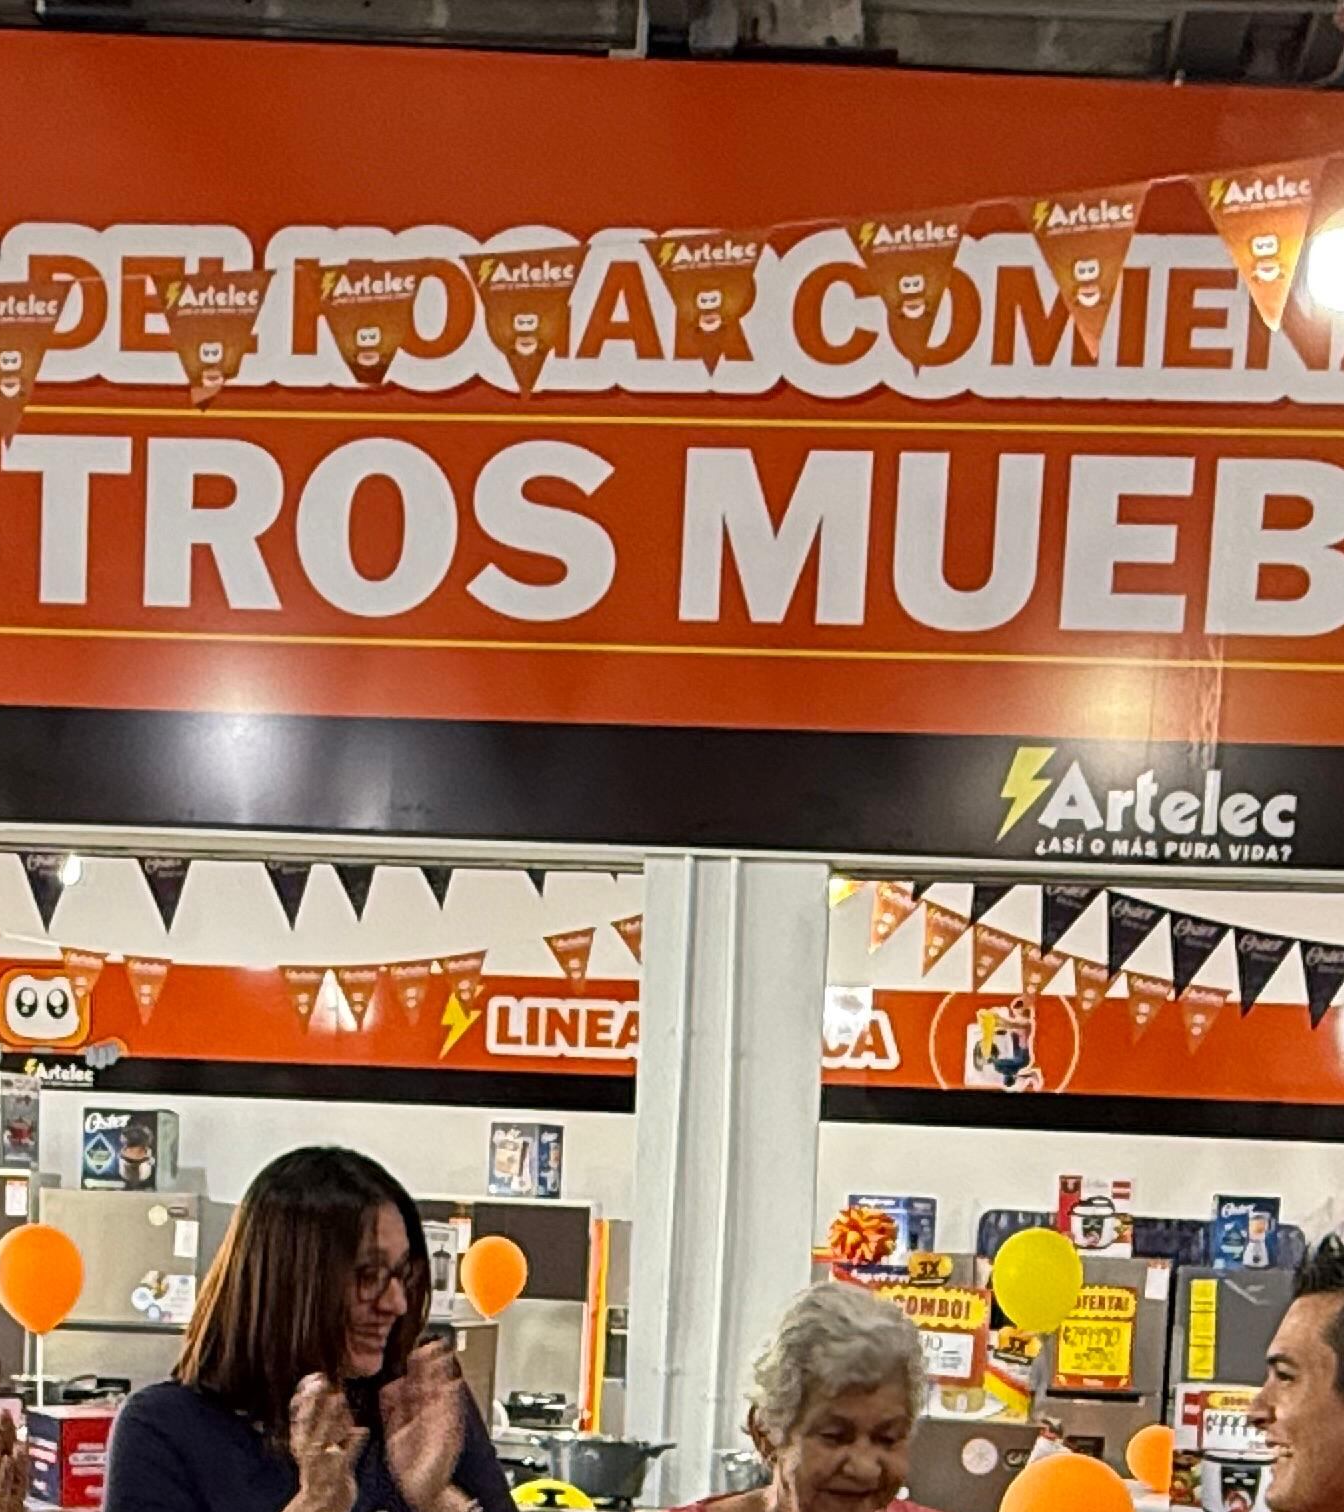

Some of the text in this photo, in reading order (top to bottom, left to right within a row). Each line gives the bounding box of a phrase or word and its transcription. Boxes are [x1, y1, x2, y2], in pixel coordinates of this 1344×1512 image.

[1223, 176, 1313, 204] Artelec
[1047, 199, 1134, 229] Artelec
[872, 219, 959, 247] Artelec
[672, 240, 758, 265] Artelec
[332, 271, 416, 297] Artelec
[490, 260, 574, 284] Artelec
[16, 245, 266, 365] DE
[178, 283, 259, 308] Artelec
[1037, 760, 1298, 839] Artelec
[1035, 833, 1293, 862] ¿ASÍ O MÁS PURA VIDA?
[494, 1004, 639, 1050] LINEA
[36, 1062, 94, 1083] Artelec
[85, 1113, 131, 1132] Oster
